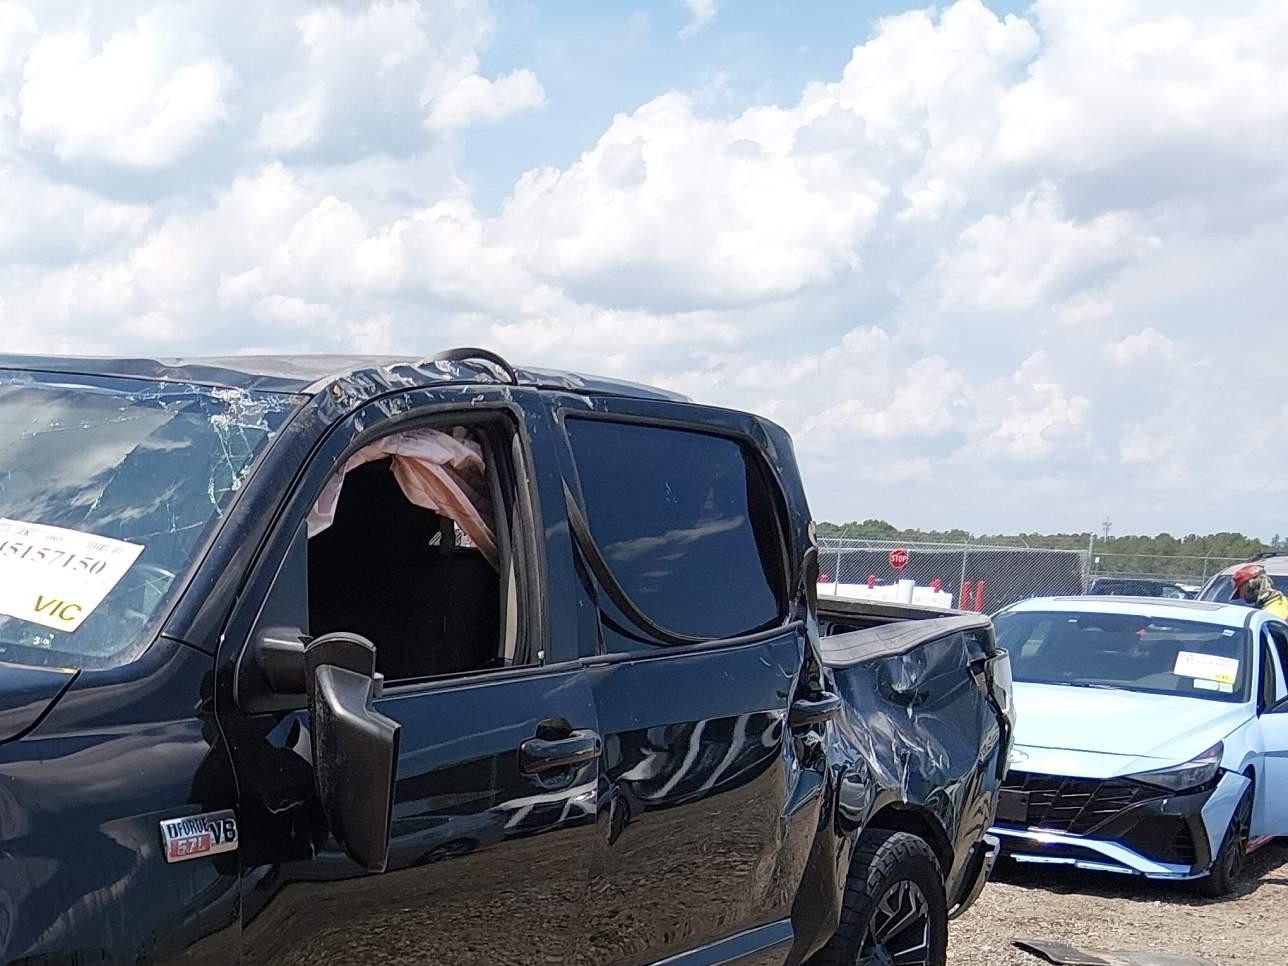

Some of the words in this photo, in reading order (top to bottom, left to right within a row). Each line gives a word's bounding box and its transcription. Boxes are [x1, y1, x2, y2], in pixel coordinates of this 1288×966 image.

[891, 553, 907, 563] STOP
[33, 594, 83, 622] VIC
[209, 818, 238, 845] V8
